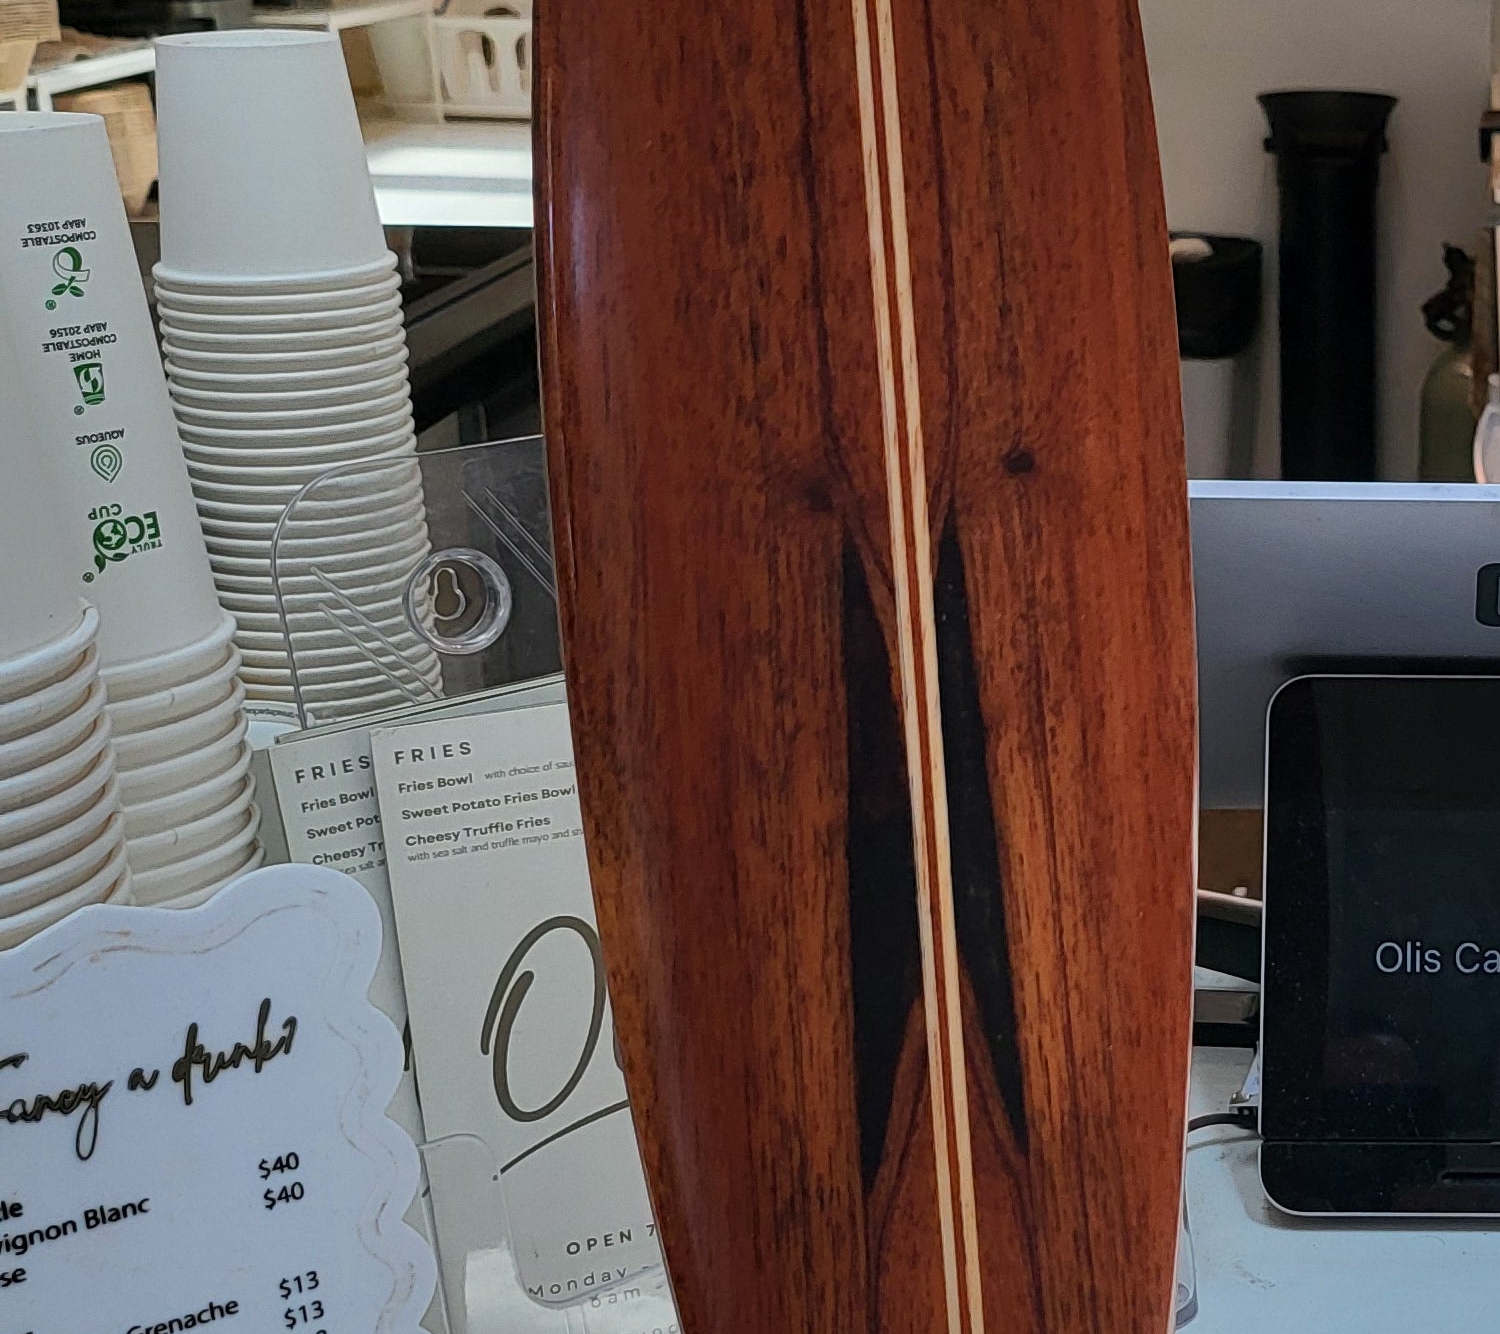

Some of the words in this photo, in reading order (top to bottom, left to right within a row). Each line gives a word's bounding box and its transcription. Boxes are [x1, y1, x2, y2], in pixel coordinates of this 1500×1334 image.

[27, 220, 61, 233] 10363
[60, 218, 87, 230] ABAP
[21, 230, 97, 248] COMPOSTABLE
[49, 324, 82, 338] 20156
[82, 322, 108, 334] ABAP
[42, 333, 117, 352] COMPOSTABLE
[70, 349, 101, 362] HOME
[76, 428, 125, 446] AQUEOUS
[88, 503, 122, 522] CUP
[131, 539, 164, 555] TRULY
[394, 741, 472, 765] FRIES
[295, 755, 371, 784] FRIES
[398, 780, 435, 794] Fries
[437, 773, 474, 789] Bowl
[301, 797, 338, 814] Fries
[340, 787, 375, 806] Bowl
[402, 805, 450, 820] Sweet
[452, 797, 501, 813] Potato
[504, 791, 539, 805] Fries
[541, 784, 576, 800] Bowl
[306, 820, 353, 840] Sweet
[405, 829, 461, 847] Cheesy
[462, 821, 514, 838] Truffle
[516, 816, 551, 830] Fries
[312, 845, 366, 867] Cheesy
[408, 852, 431, 863] with
[432, 849, 451, 859] sea
[452, 845, 469, 857] salt
[471, 841, 490, 853] and
[491, 836, 520, 851] truffle
[522, 833, 550, 846] mayo
[1375, 940, 1441, 974] Olis
[128, 1068, 160, 1091] a
[258, 1152, 300, 1180] $40
[263, 1182, 305, 1211] $40
[84, 1198, 151, 1230] Blanc
[566, 1228, 633, 1256] OPEN
[279, 1270, 320, 1300] $13
[284, 1300, 325, 1330] $13
